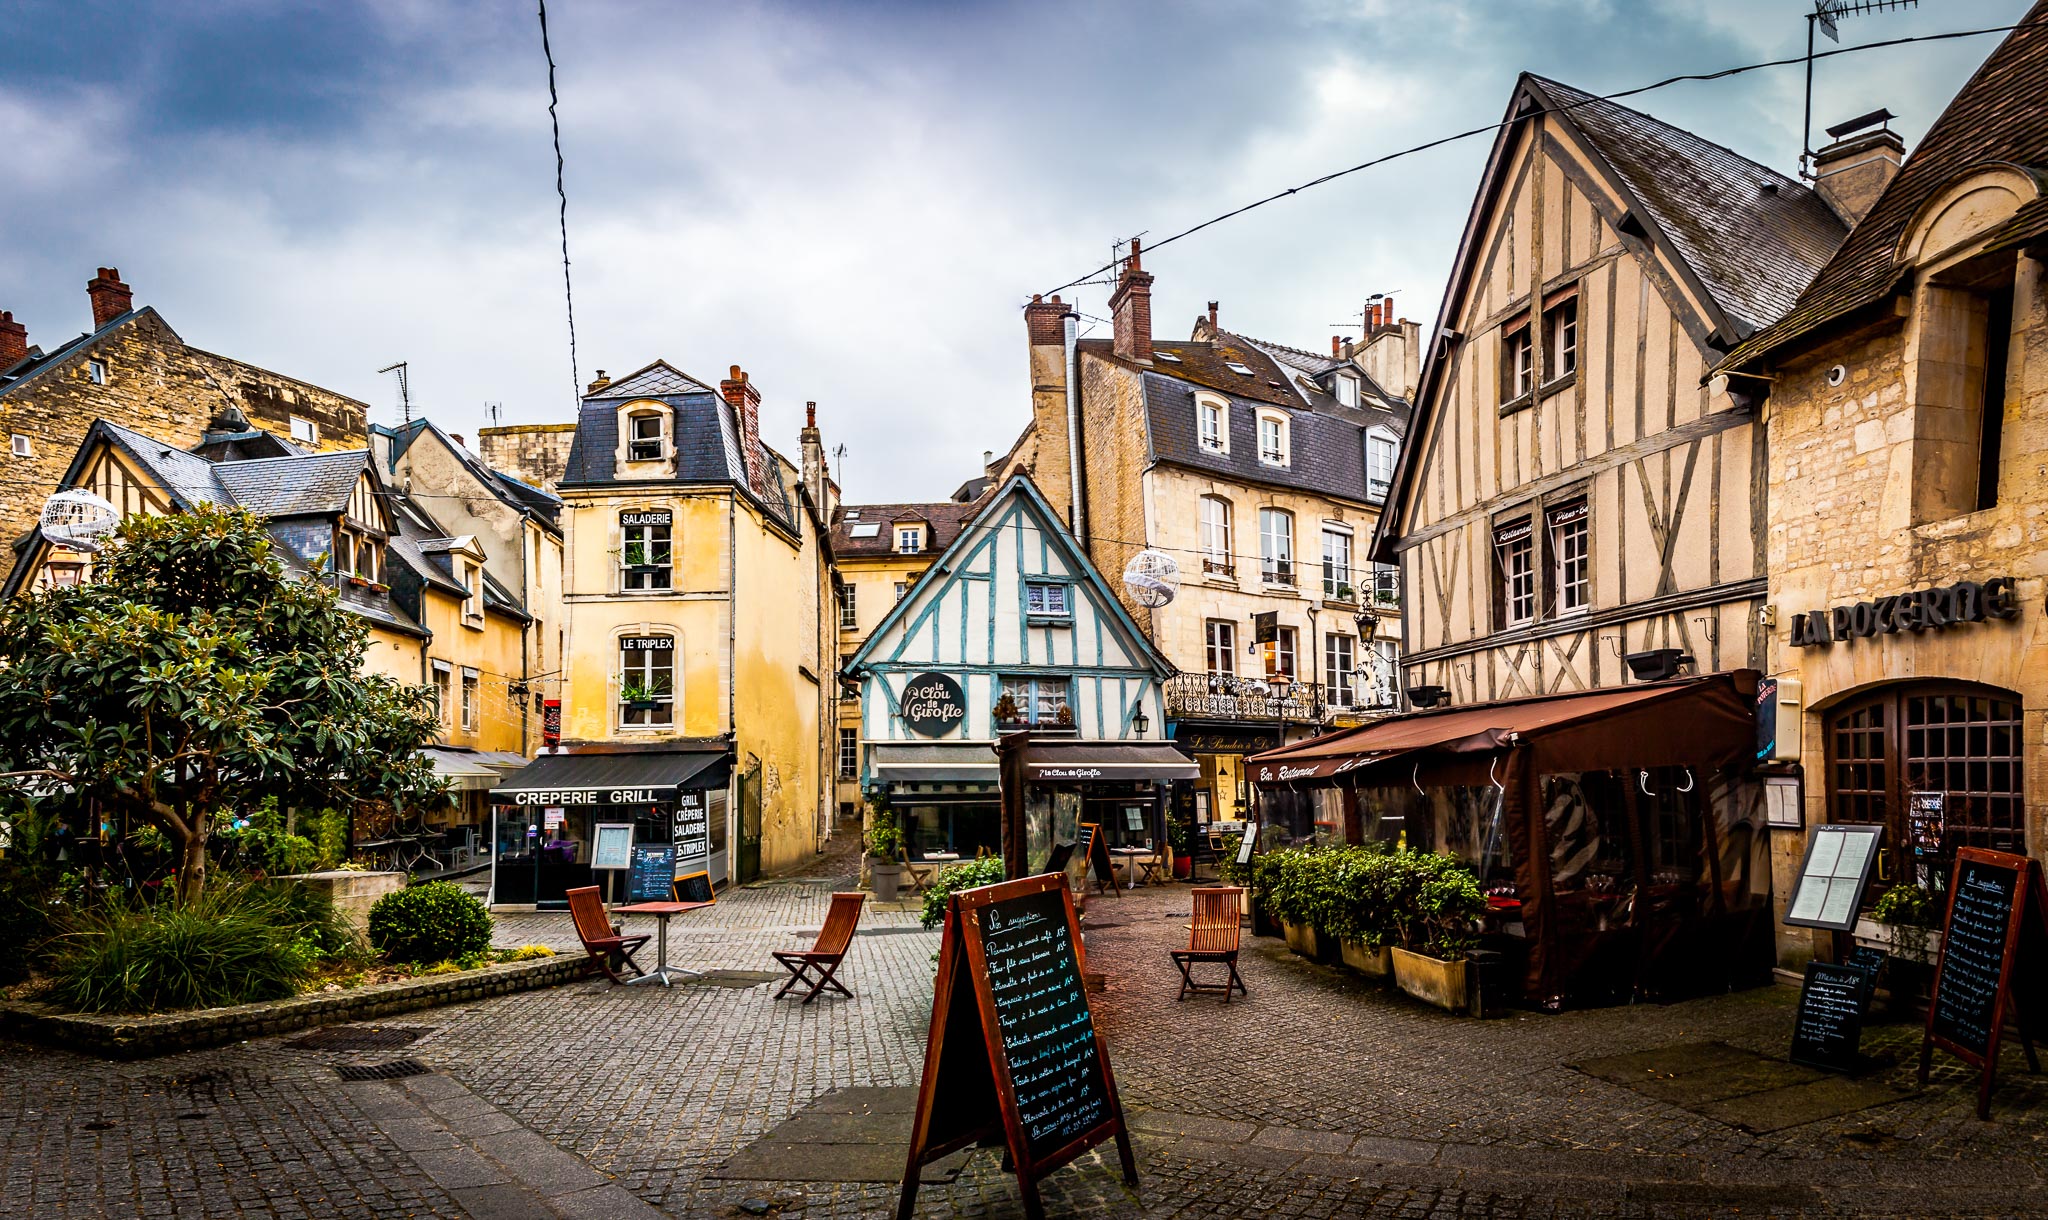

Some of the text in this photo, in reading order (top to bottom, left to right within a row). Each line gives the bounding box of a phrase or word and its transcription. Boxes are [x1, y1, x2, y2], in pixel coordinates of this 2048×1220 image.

[622, 513, 671, 525] SALADERIE
[1555, 503, 1588, 523] Piano-Ba
[1789, 577, 2022, 647] LA POTERNE
[623, 639, 673, 649] LE TRIPLEX
[920, 686, 951, 699] Clou
[1758, 682, 1767, 692] LA
[927, 700, 938, 708] de
[911, 703, 964, 723] Girofle
[1076, 768, 1102, 778] Girofle
[1260, 766, 1273, 782] Bar
[1277, 764, 1320, 781] Restaurant
[515, 790, 658, 805] CREPERIE GRILL
[681, 795, 698, 806] GRILL
[676, 807, 704, 822] CRÊPERIE
[674, 822, 706, 837] SALADERIE
[683, 841, 706, 855] TRIPLEX
